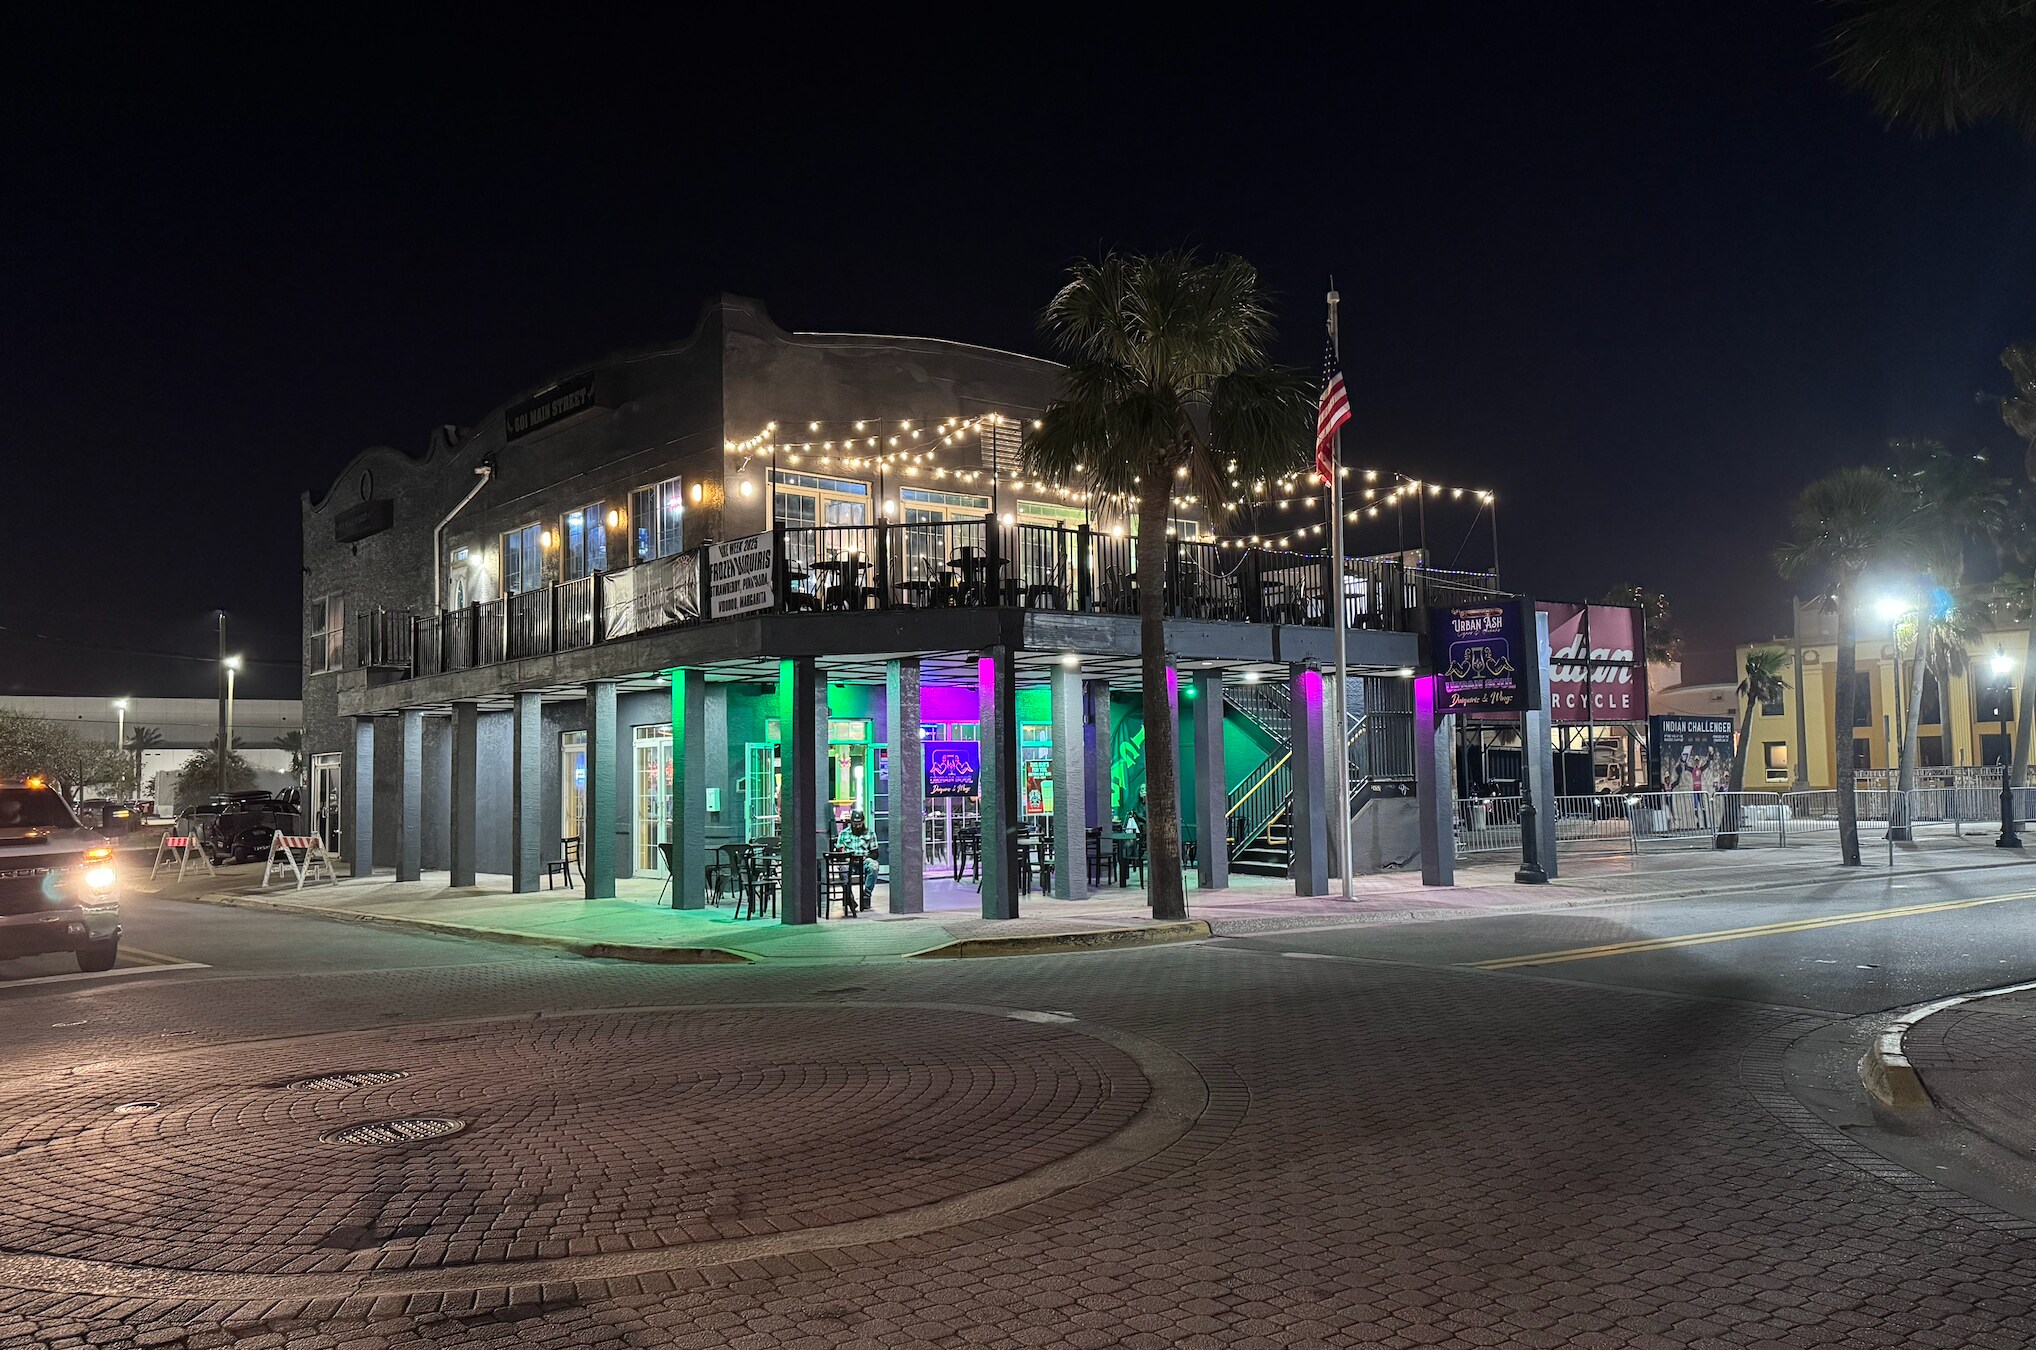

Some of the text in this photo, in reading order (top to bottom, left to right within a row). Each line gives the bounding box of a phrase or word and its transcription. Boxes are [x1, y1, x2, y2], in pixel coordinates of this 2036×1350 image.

[529, 402, 551, 427] MAIN
[552, 387, 588, 417] STREET
[1451, 619, 1482, 632] URBAN
[1483, 616, 1502, 631] ASH
[1662, 720, 1732, 733] INDIAN CHALLENGER
